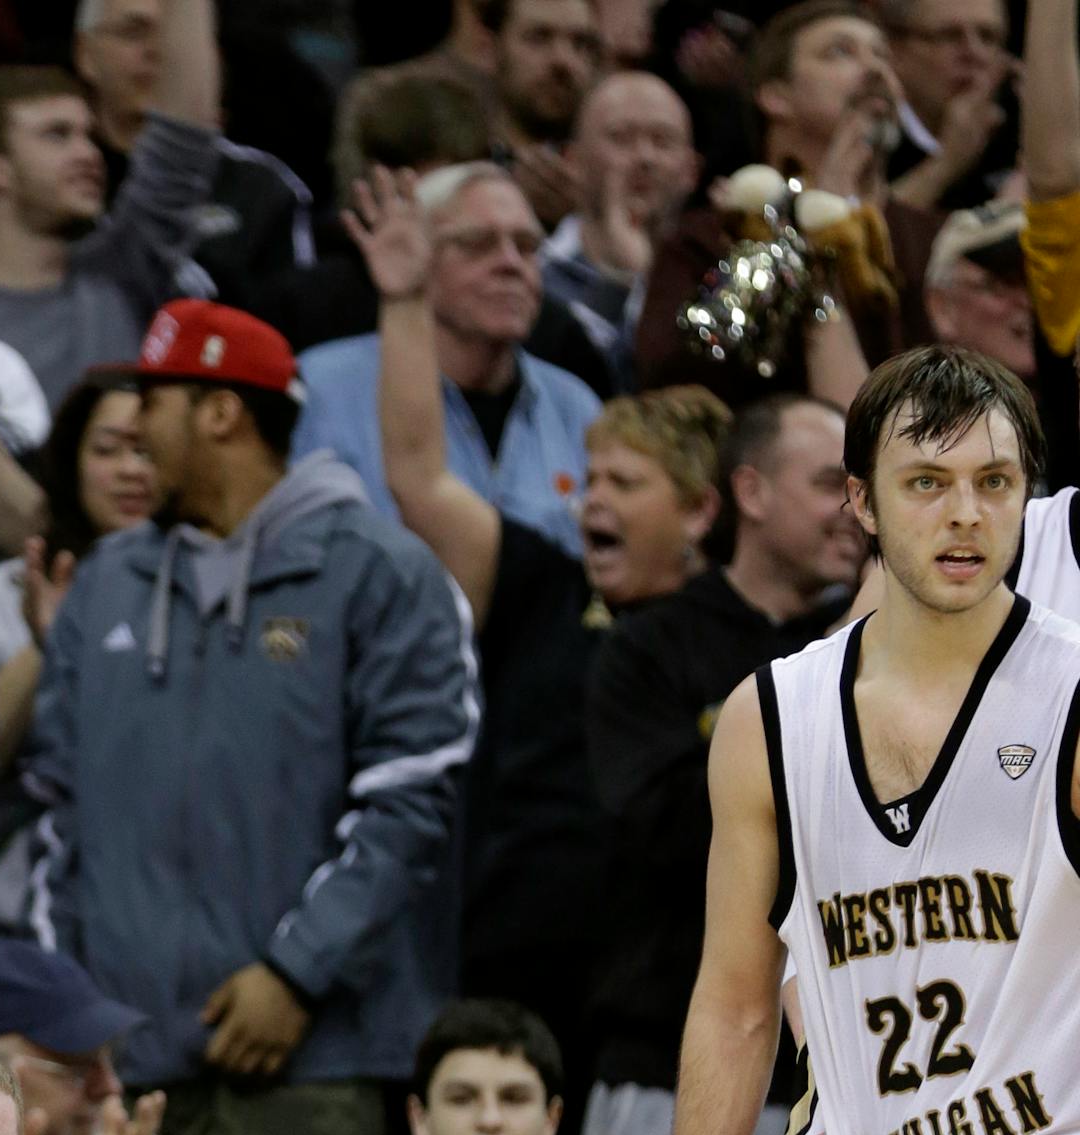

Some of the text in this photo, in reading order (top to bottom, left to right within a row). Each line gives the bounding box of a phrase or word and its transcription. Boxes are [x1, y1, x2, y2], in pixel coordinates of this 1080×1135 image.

[1001, 755, 1032, 766] MAC
[885, 803, 911, 834] W
[817, 869, 1021, 969] WESTERN
[865, 978, 978, 1098] 22
